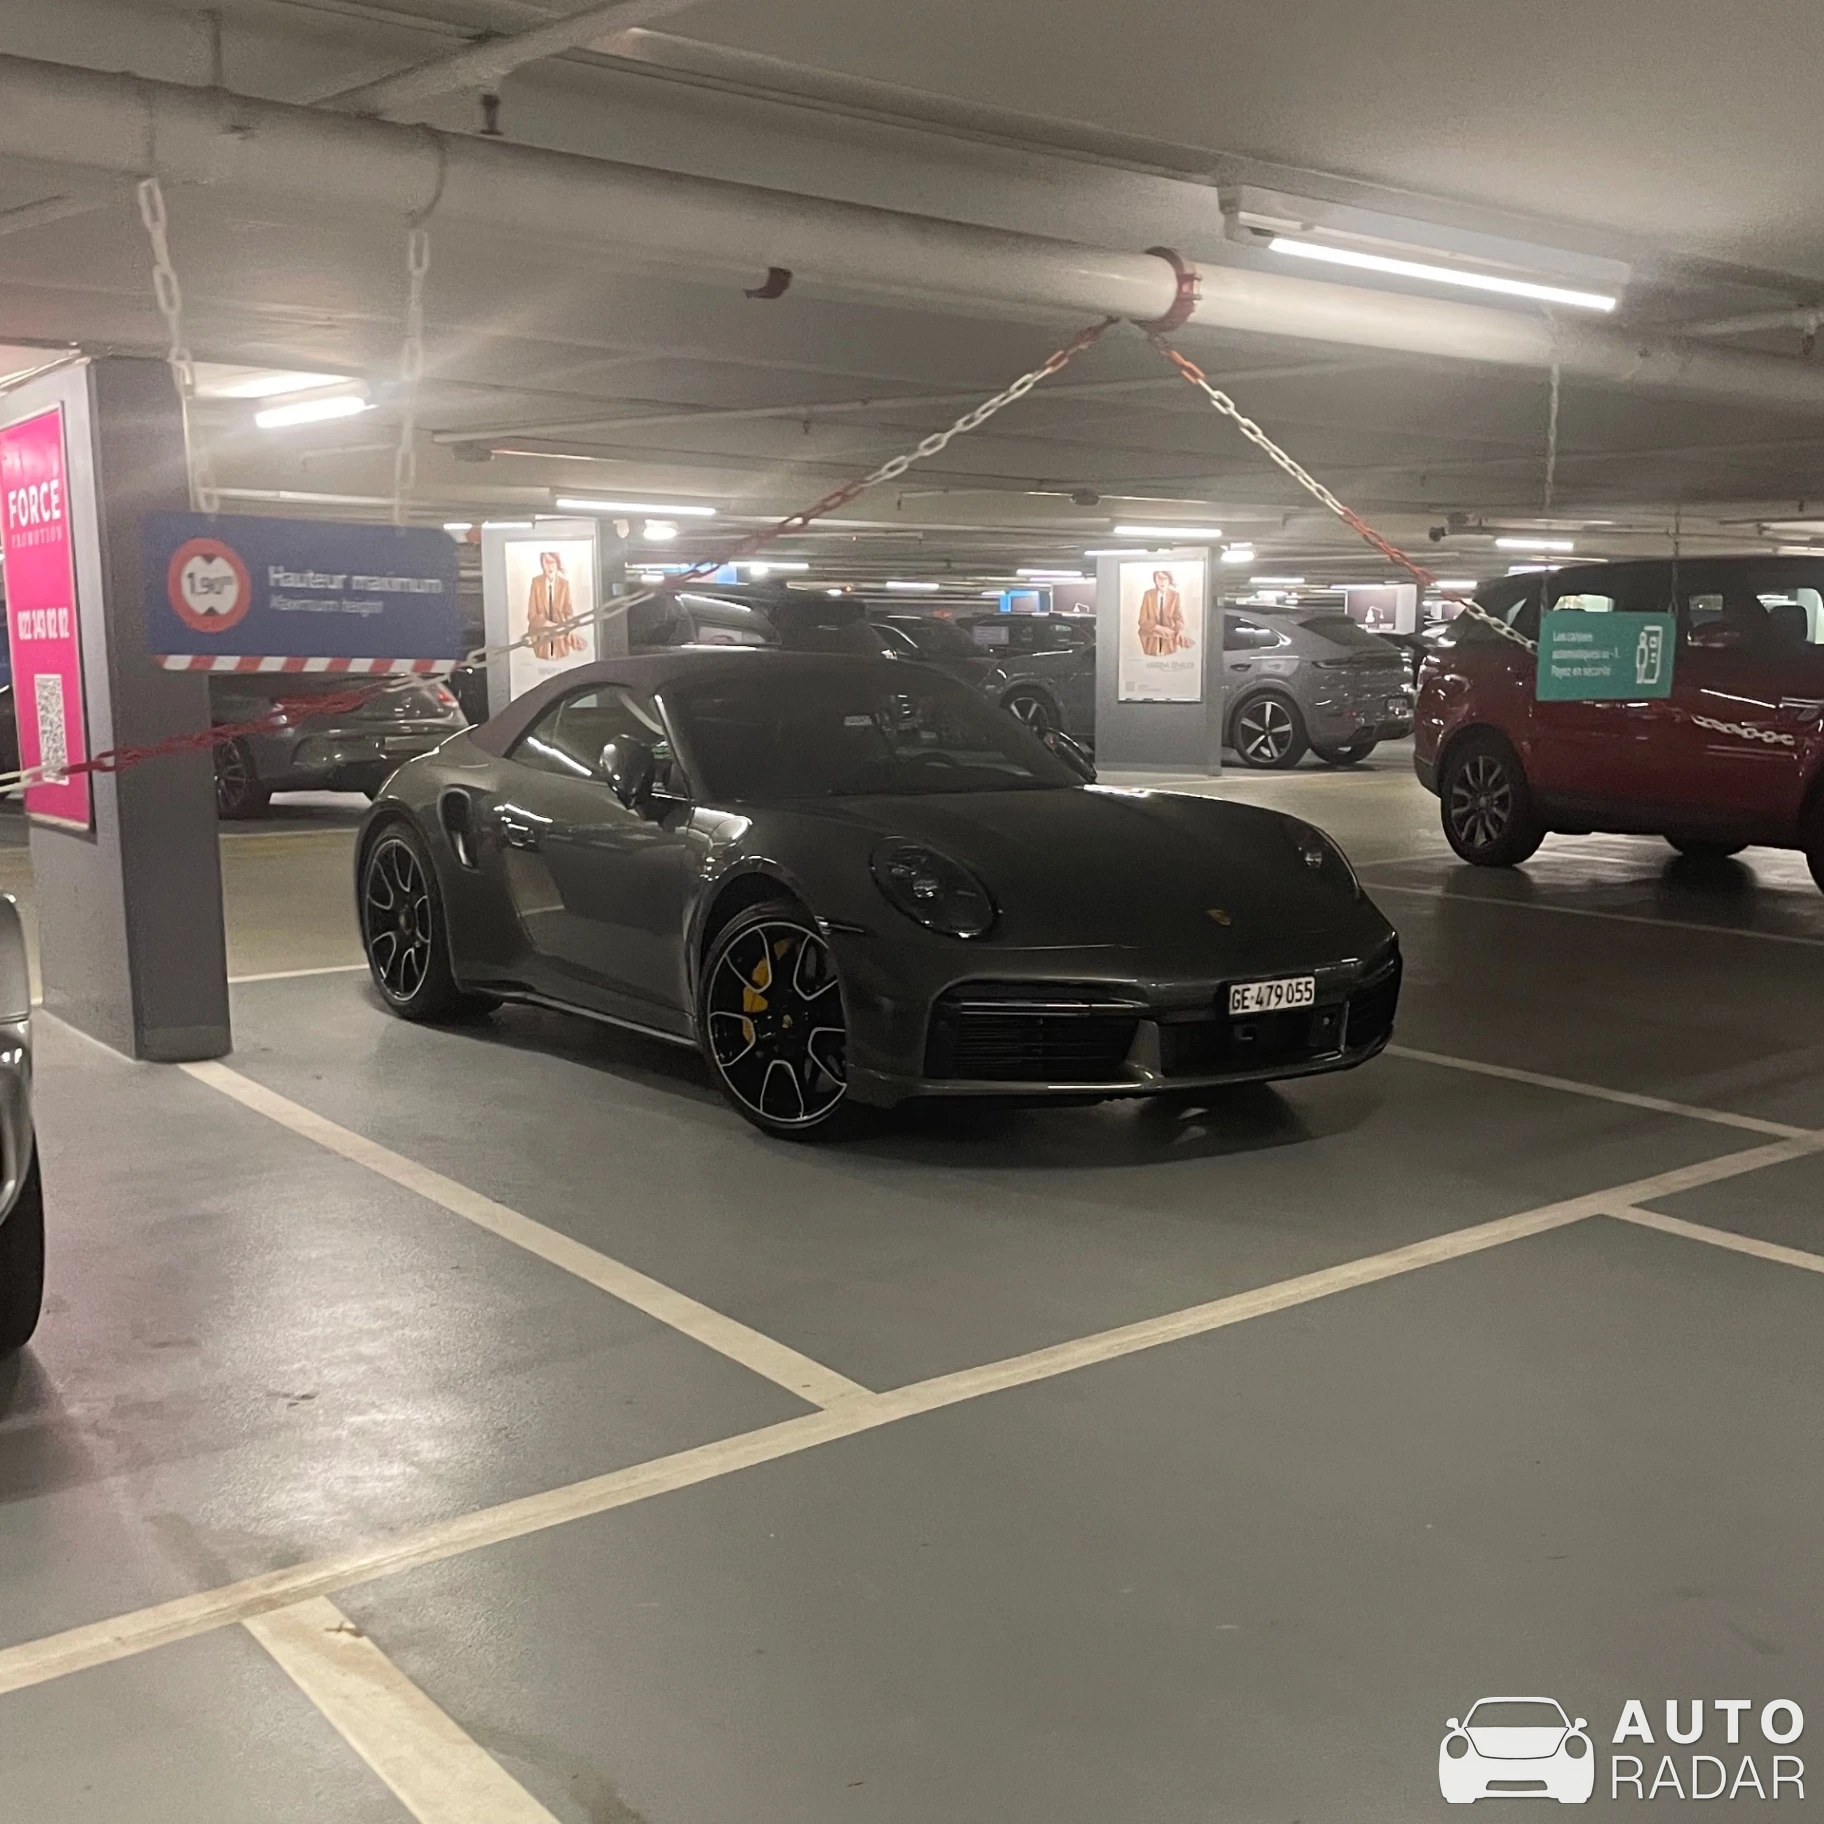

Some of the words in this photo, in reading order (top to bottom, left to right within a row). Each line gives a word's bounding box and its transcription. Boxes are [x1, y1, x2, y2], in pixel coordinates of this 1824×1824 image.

[8, 479, 61, 530] FORCE
[268, 566, 347, 590] Hauteur
[1286, 981, 1313, 1004] 055
